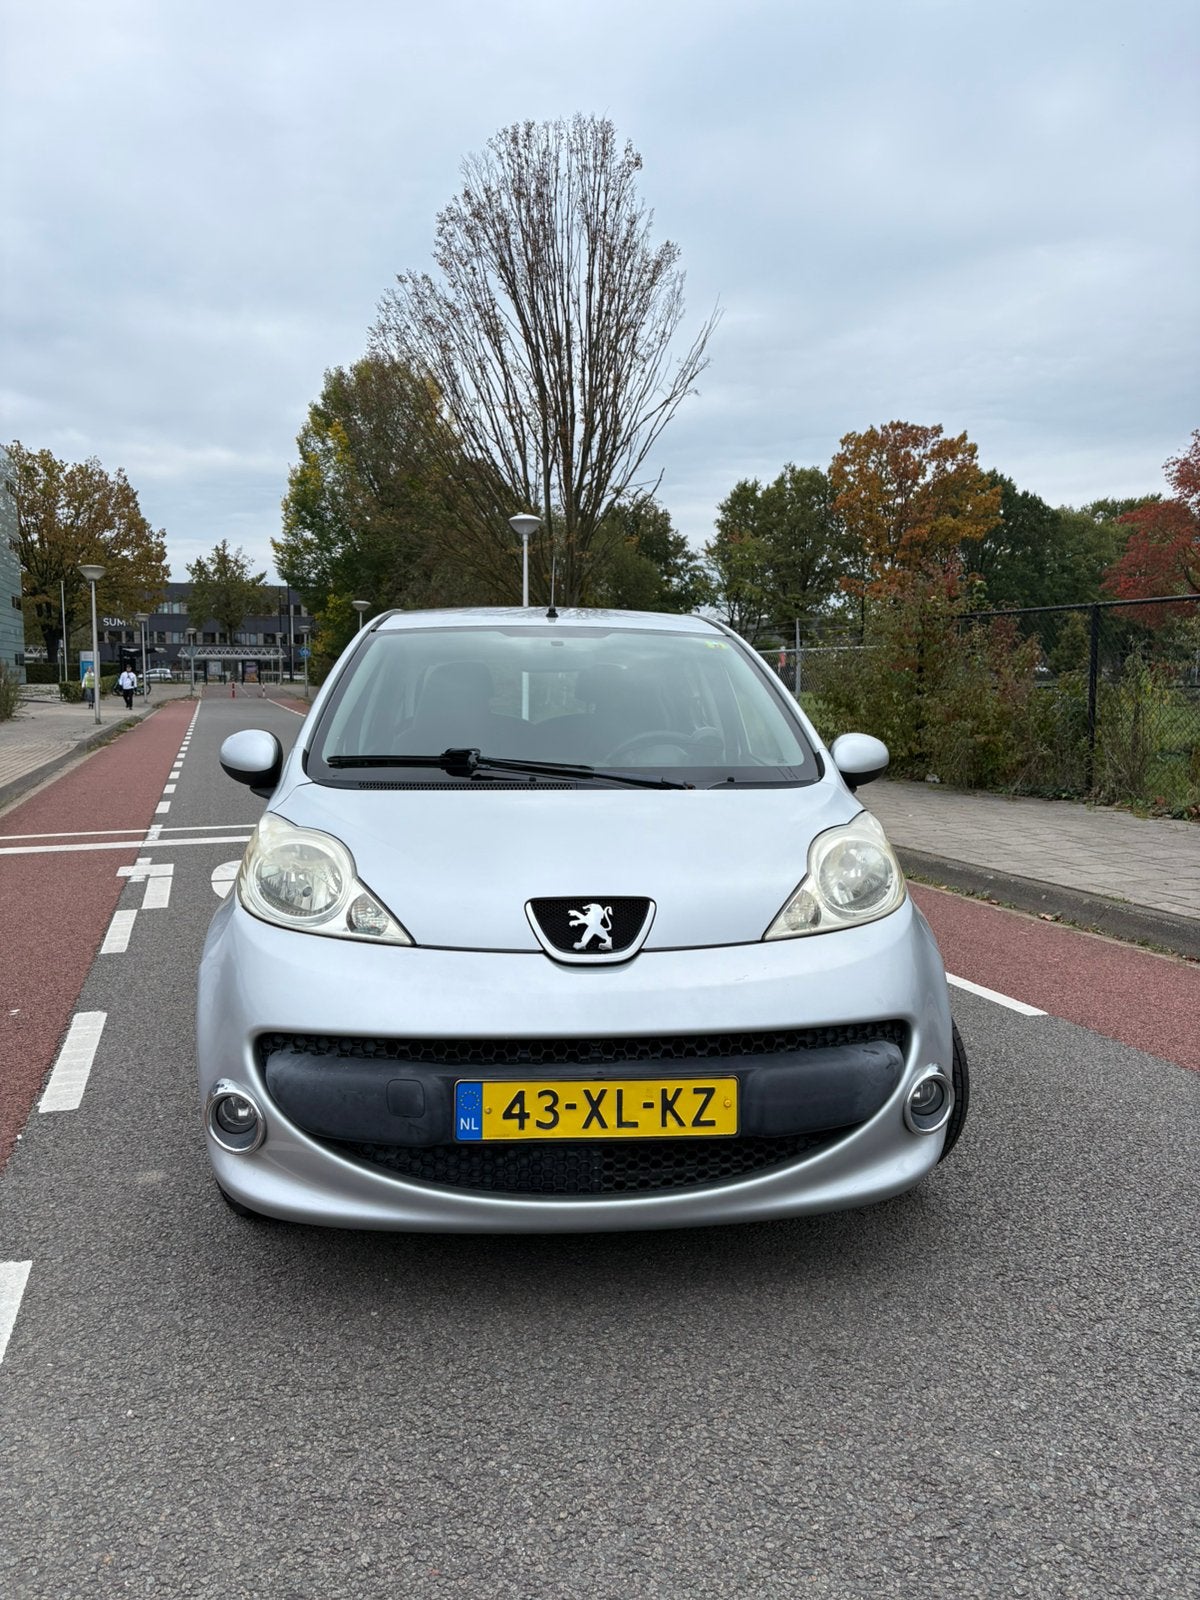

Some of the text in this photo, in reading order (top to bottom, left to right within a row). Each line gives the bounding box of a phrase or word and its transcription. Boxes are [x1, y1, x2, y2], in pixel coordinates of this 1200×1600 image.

[103, 617, 139, 627] SUM
[502, 1087, 717, 1131] 43-XL-KZ
[460, 1118, 479, 1131] NL
